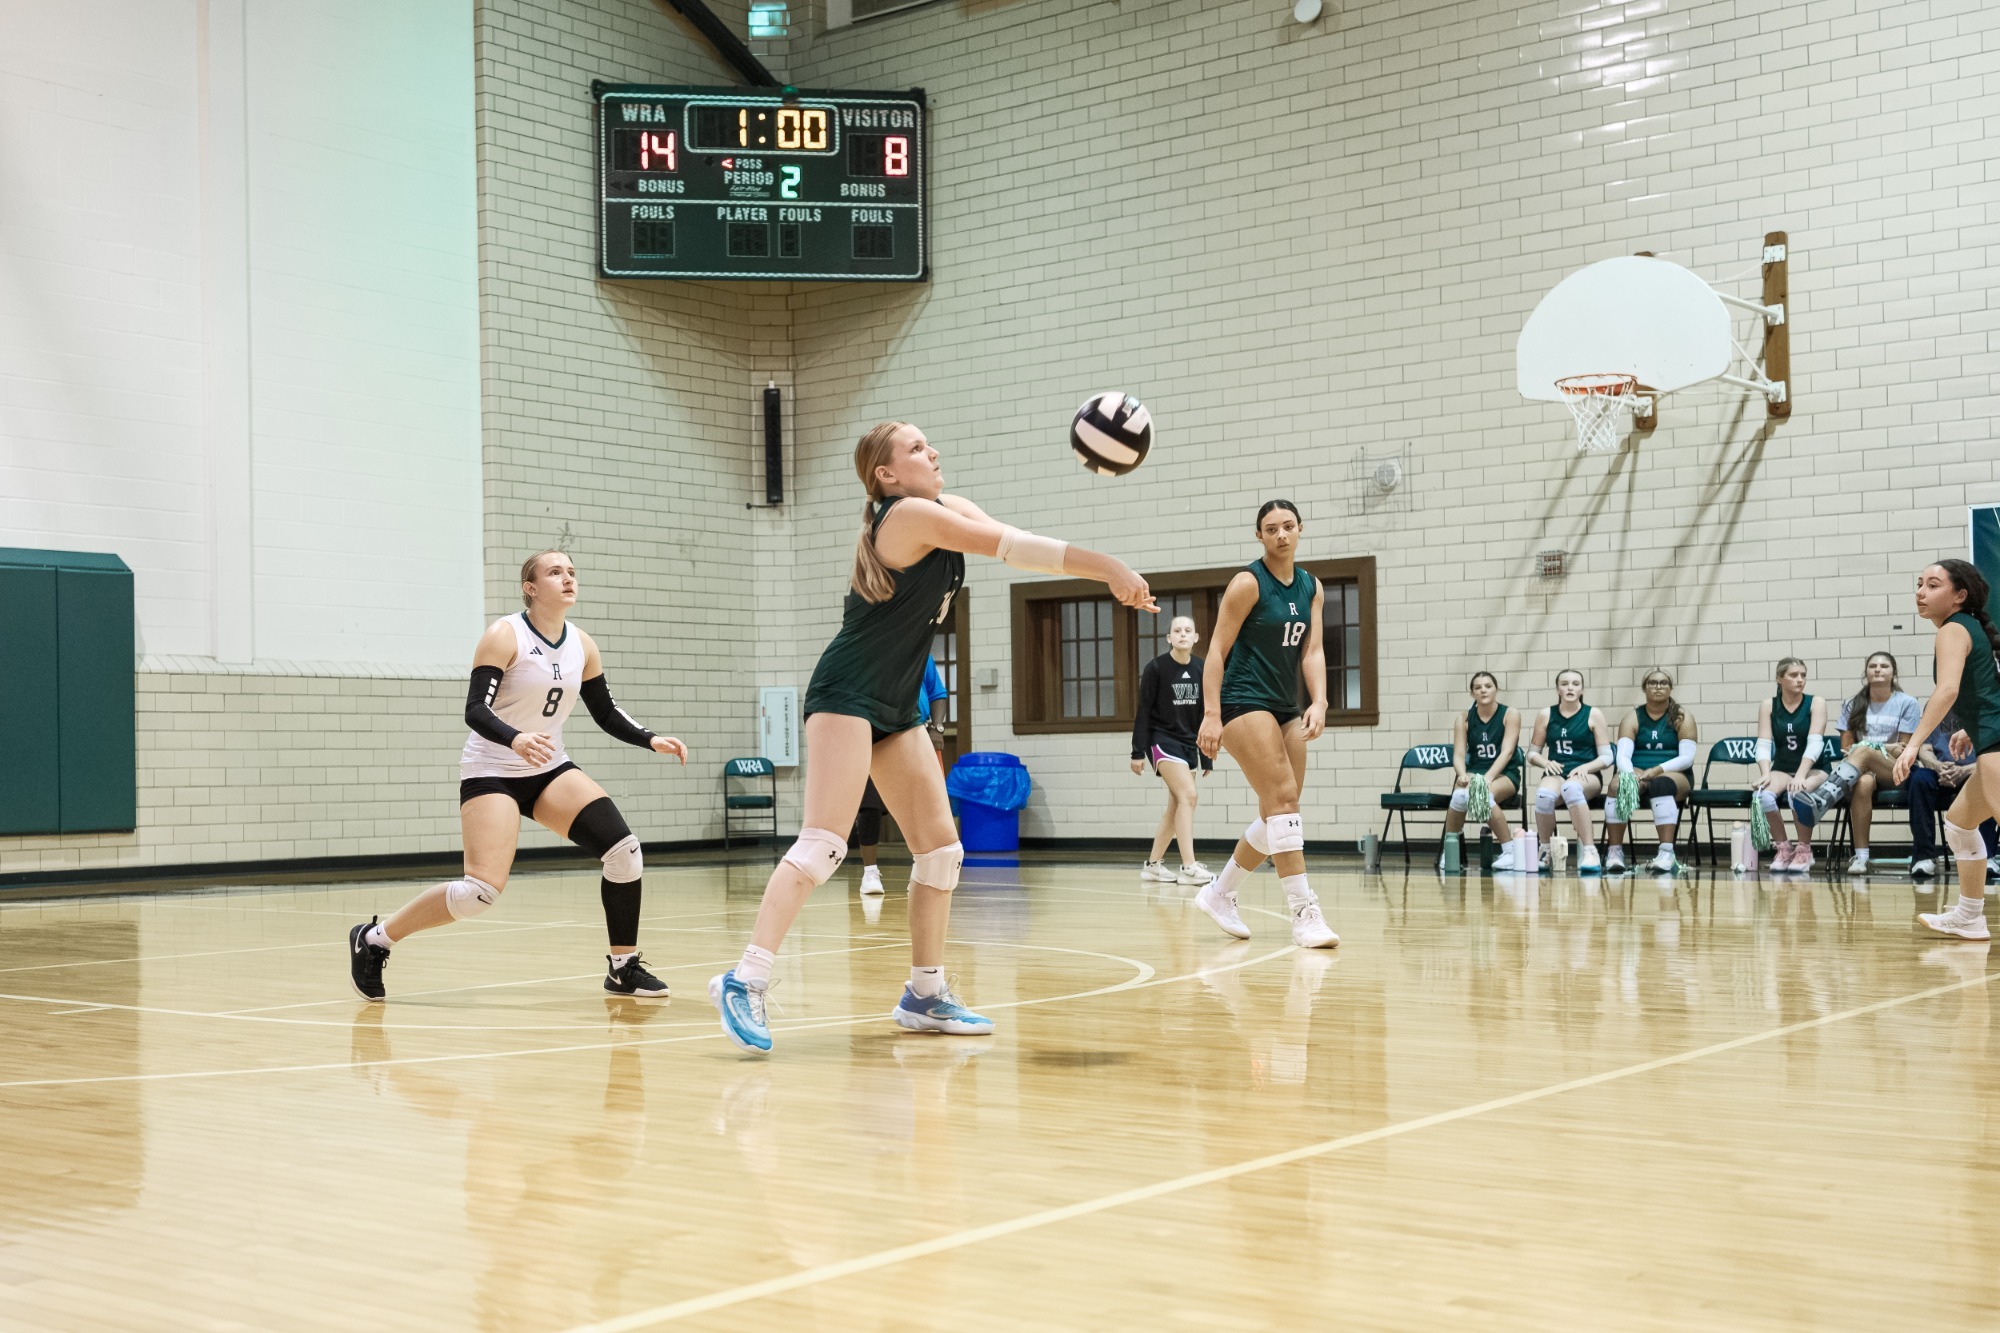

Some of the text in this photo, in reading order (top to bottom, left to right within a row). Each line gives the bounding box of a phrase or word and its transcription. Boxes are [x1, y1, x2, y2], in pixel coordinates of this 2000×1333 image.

[621, 103, 667, 123] WRA
[842, 108, 914, 128] VISITOR
[739, 108, 827, 149] 1:00
[640, 131, 675, 171] 14
[885, 135, 908, 176] 8
[735, 158, 763, 169] POSS
[723, 171, 774, 185] PERIOD
[781, 165, 801, 199] 2
[638, 179, 685, 194] BONUS
[840, 183, 886, 197] BONUS
[631, 205, 675, 219] FOULS
[717, 207, 821, 222] PLAYER FOULS
[851, 209, 894, 223] FOULS
[1288, 602, 1299, 616] R
[1282, 621, 1307, 647] 18
[552, 663, 562, 680] R
[542, 687, 563, 717] 8
[1561, 727, 1568, 737] R
[1651, 730, 1659, 740] R
[1476, 743, 1497, 758] 20
[1555, 740, 1574, 755] 15
[1786, 735, 1798, 751] 5
[1414, 747, 1450, 765] WRA
[735, 759, 764, 773] WRA
